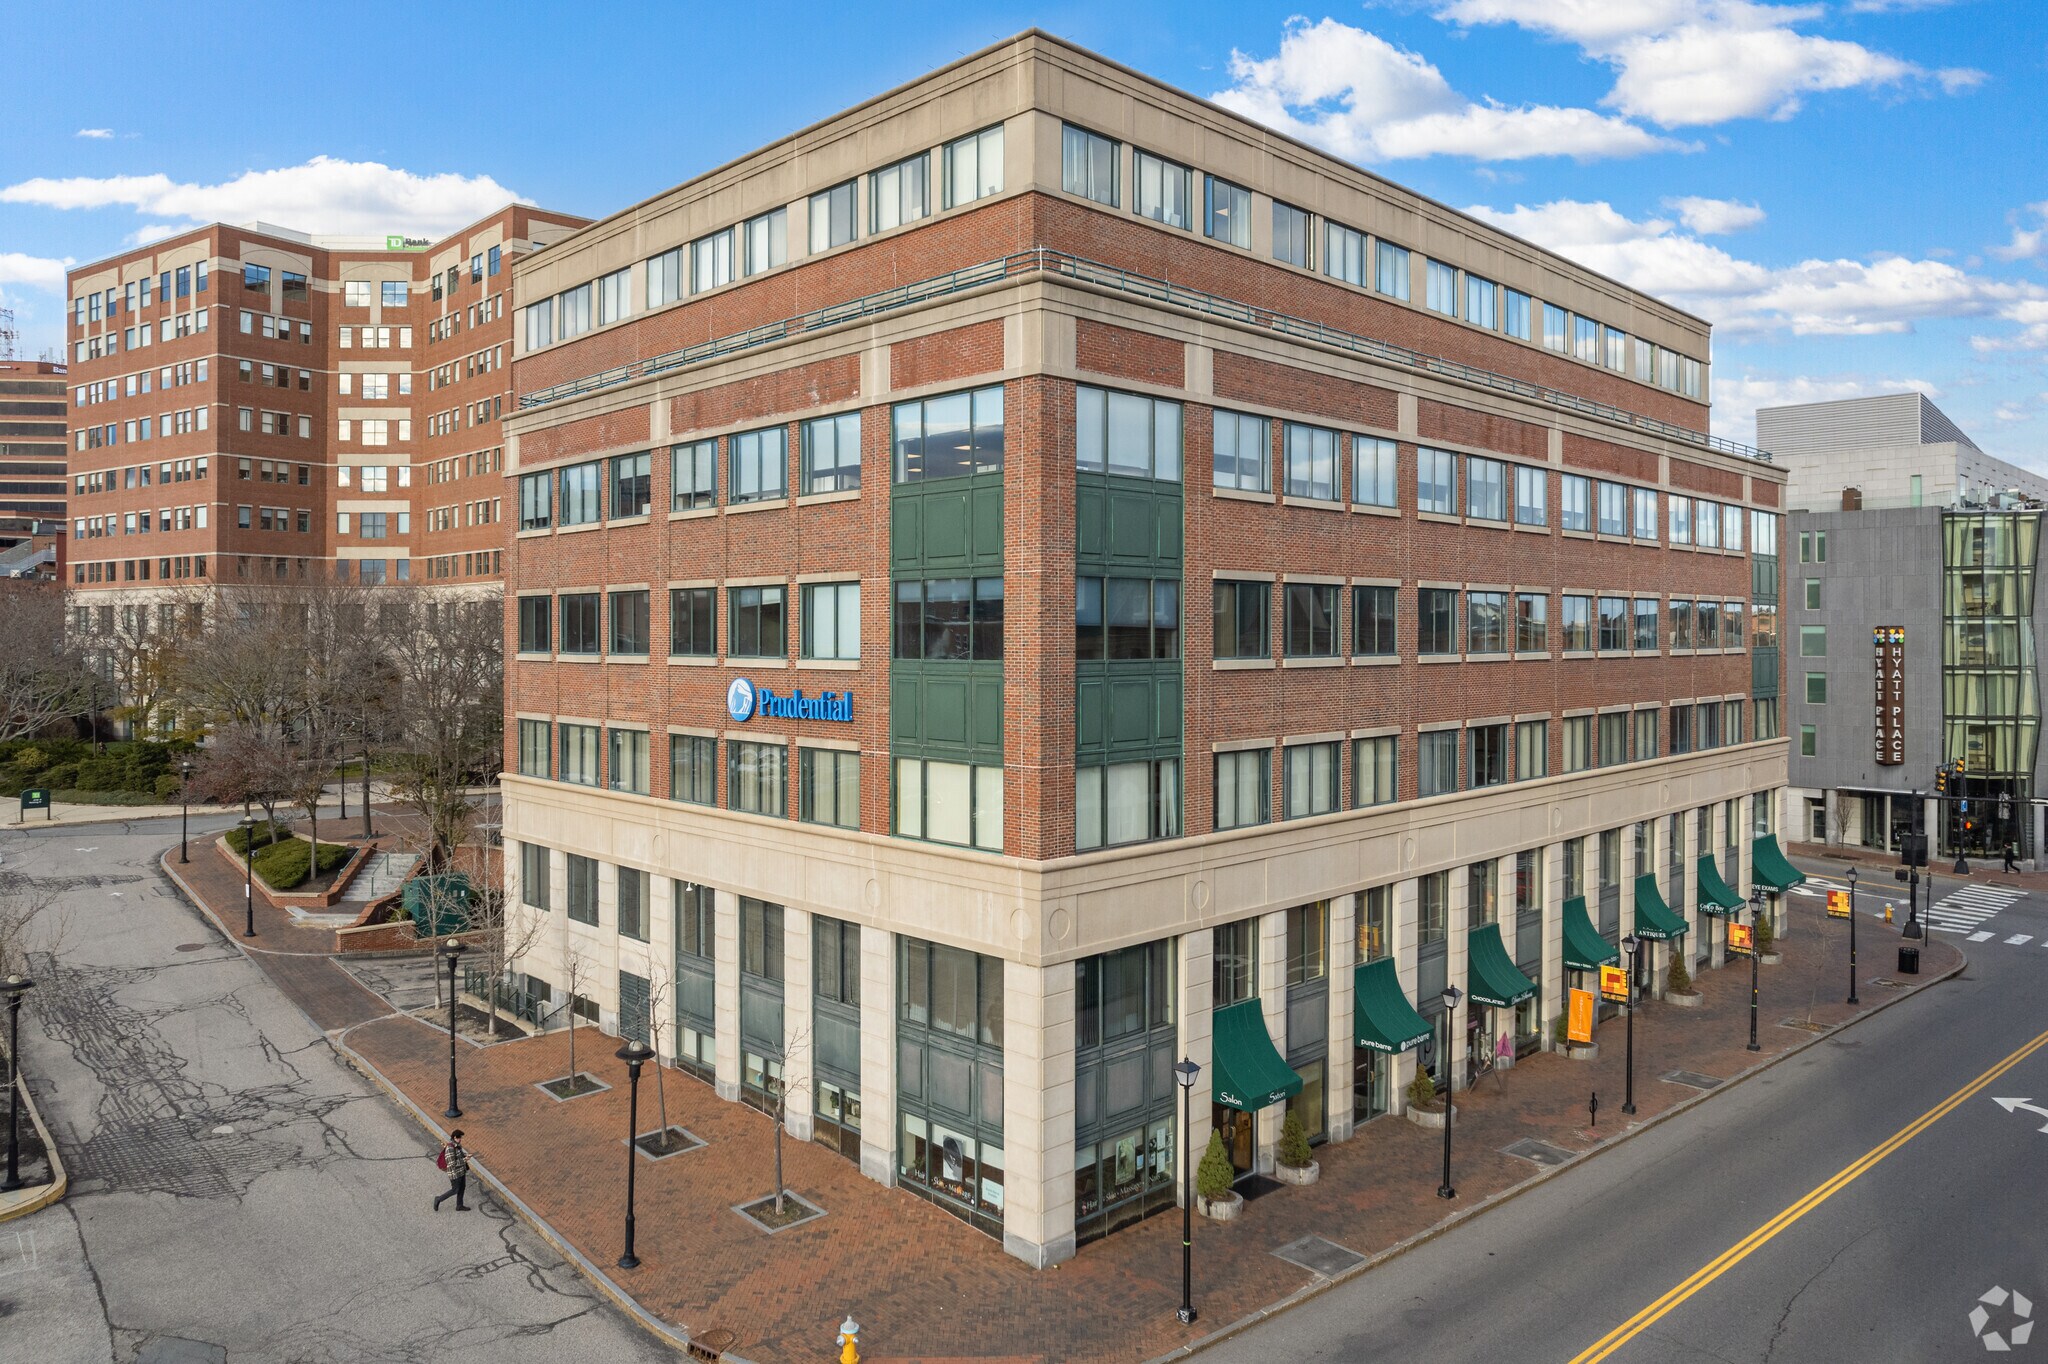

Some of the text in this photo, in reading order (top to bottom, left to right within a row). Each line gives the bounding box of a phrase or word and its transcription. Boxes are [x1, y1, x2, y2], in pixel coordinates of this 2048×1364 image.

[388, 237, 429, 247] TD Bank
[758, 687, 854, 722] Prudential
[1875, 647, 1885, 761] HYATT PLACE
[1892, 647, 1902, 762] HYATT PLACE
[1638, 930, 1667, 938] ANTIQUES
[1471, 994, 1506, 1006] CHOCOLATIER
[1220, 1091, 1243, 1106] Salon
